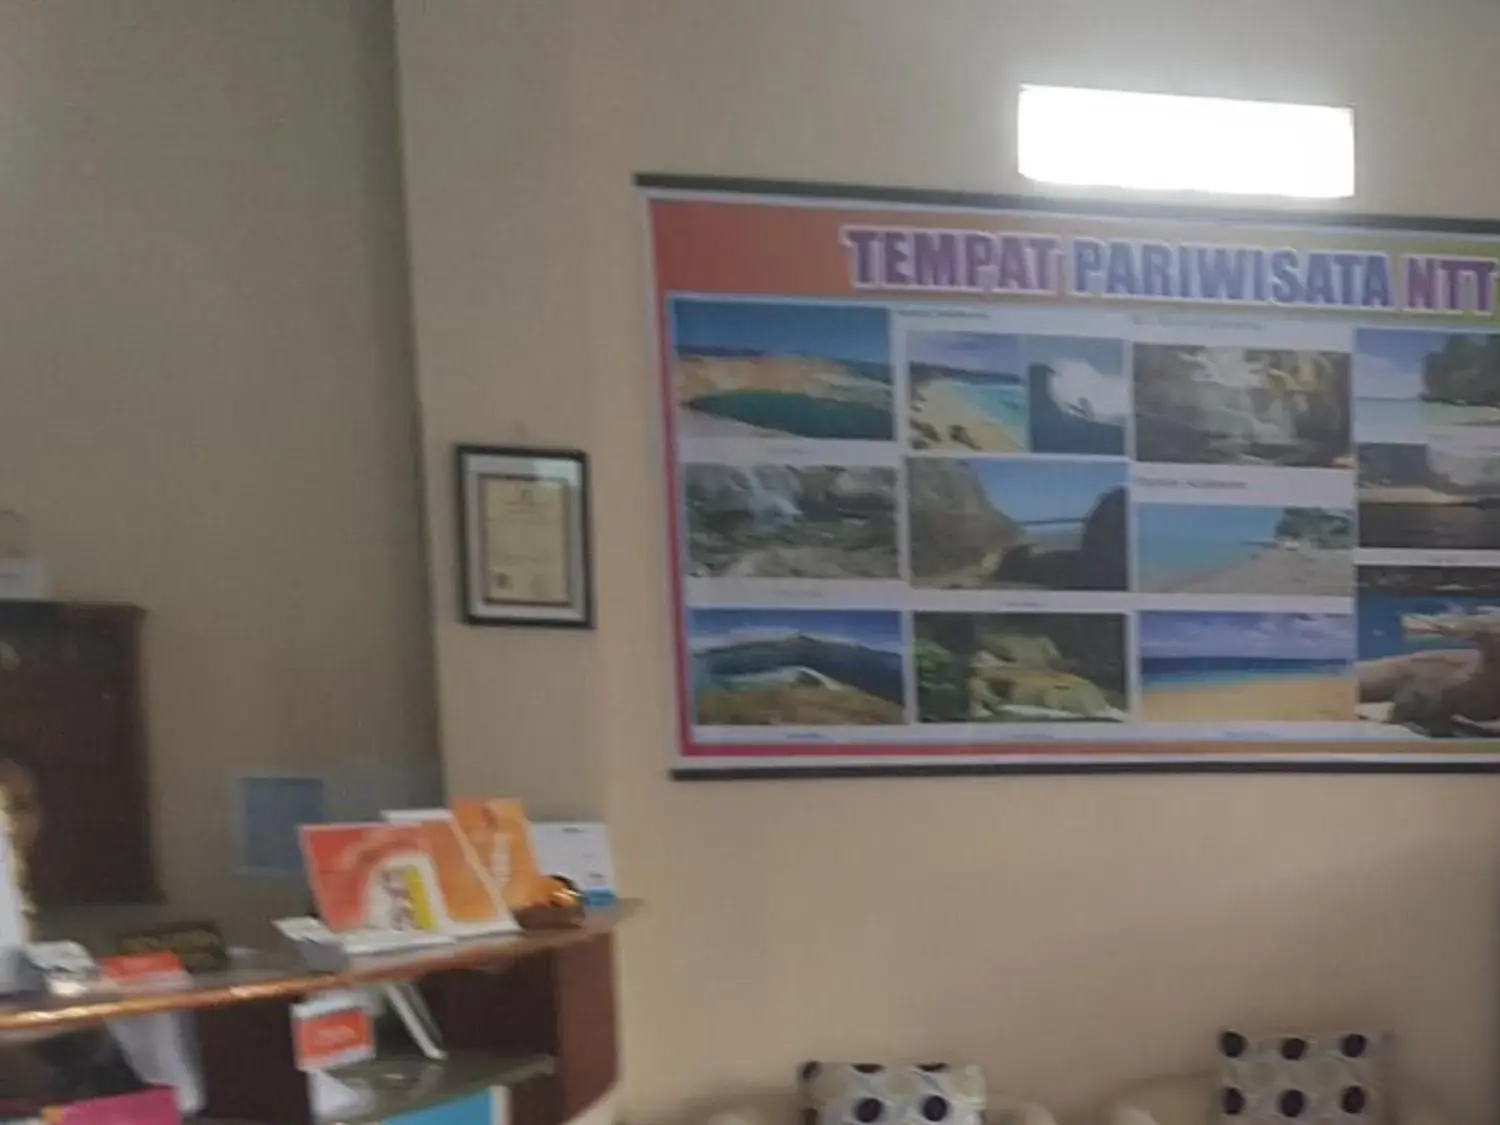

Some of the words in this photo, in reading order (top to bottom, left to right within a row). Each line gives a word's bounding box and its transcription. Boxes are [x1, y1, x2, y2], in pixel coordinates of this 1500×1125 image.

[843, 228, 1060, 293] TEMPAT
[1071, 237, 1391, 309] PARIWISATA
[1406, 256, 1497, 314] NTT
